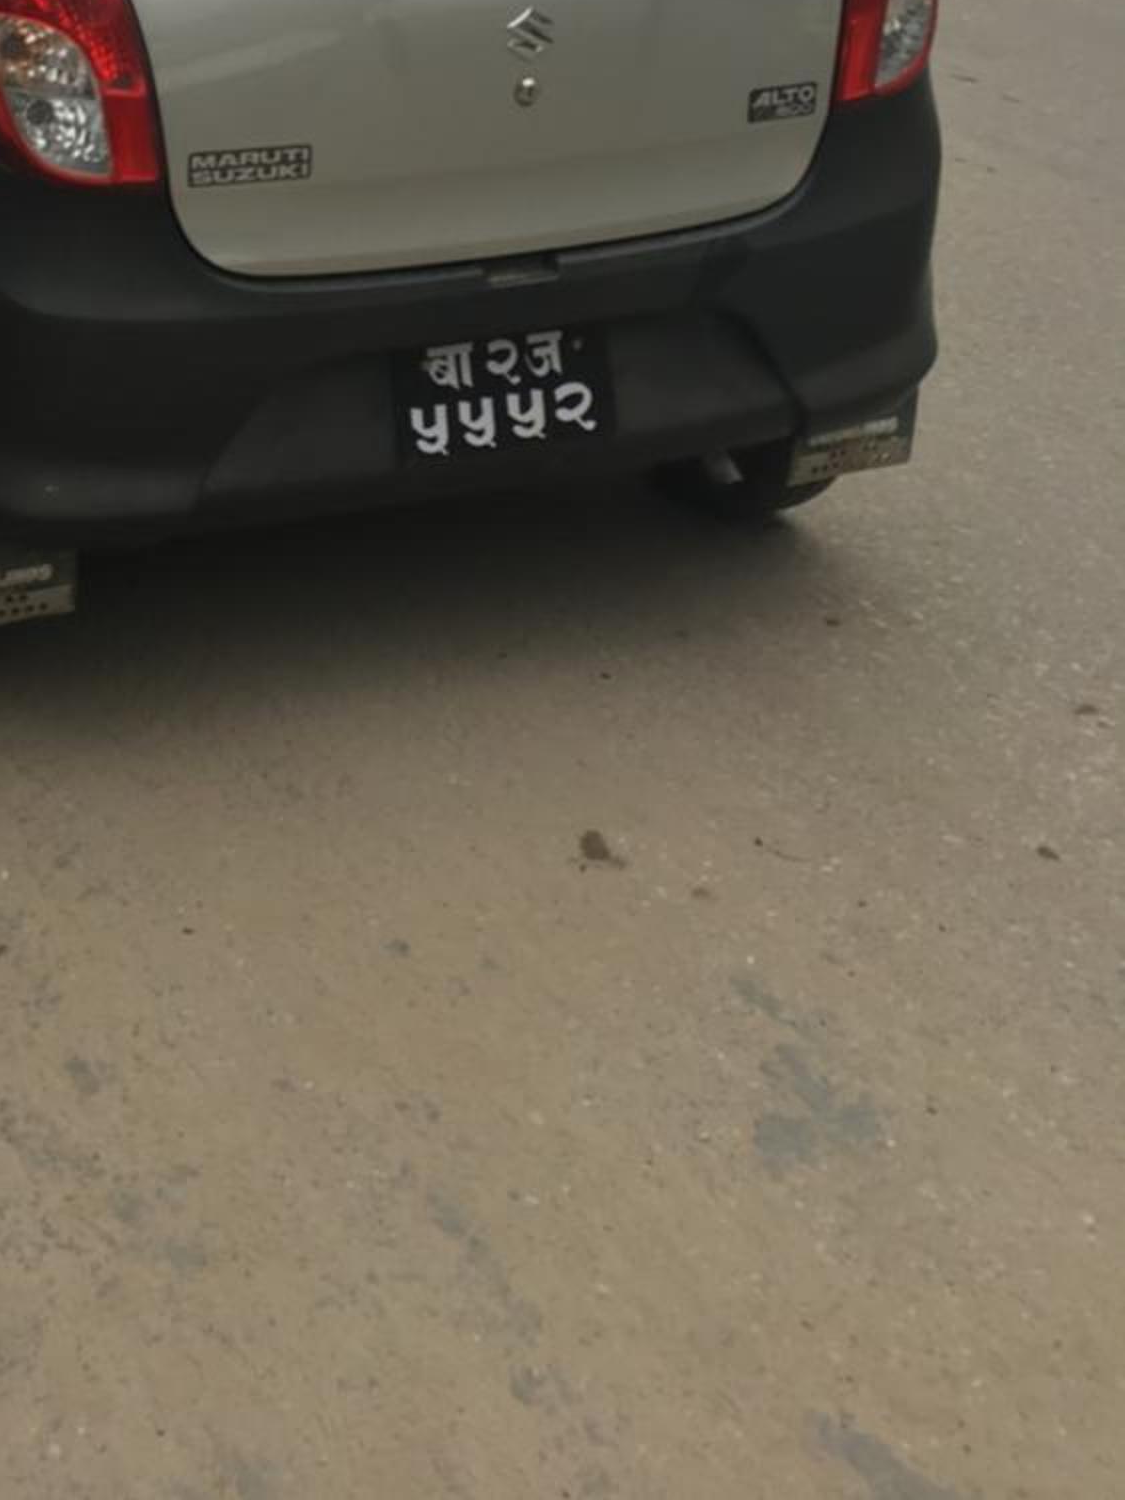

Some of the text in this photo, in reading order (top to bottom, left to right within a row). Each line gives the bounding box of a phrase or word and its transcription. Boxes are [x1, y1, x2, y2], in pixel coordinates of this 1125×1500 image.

[752, 85, 813, 108] ALTO
[191, 148, 309, 169] MARUTI
[191, 163, 309, 184] SUZUKI
